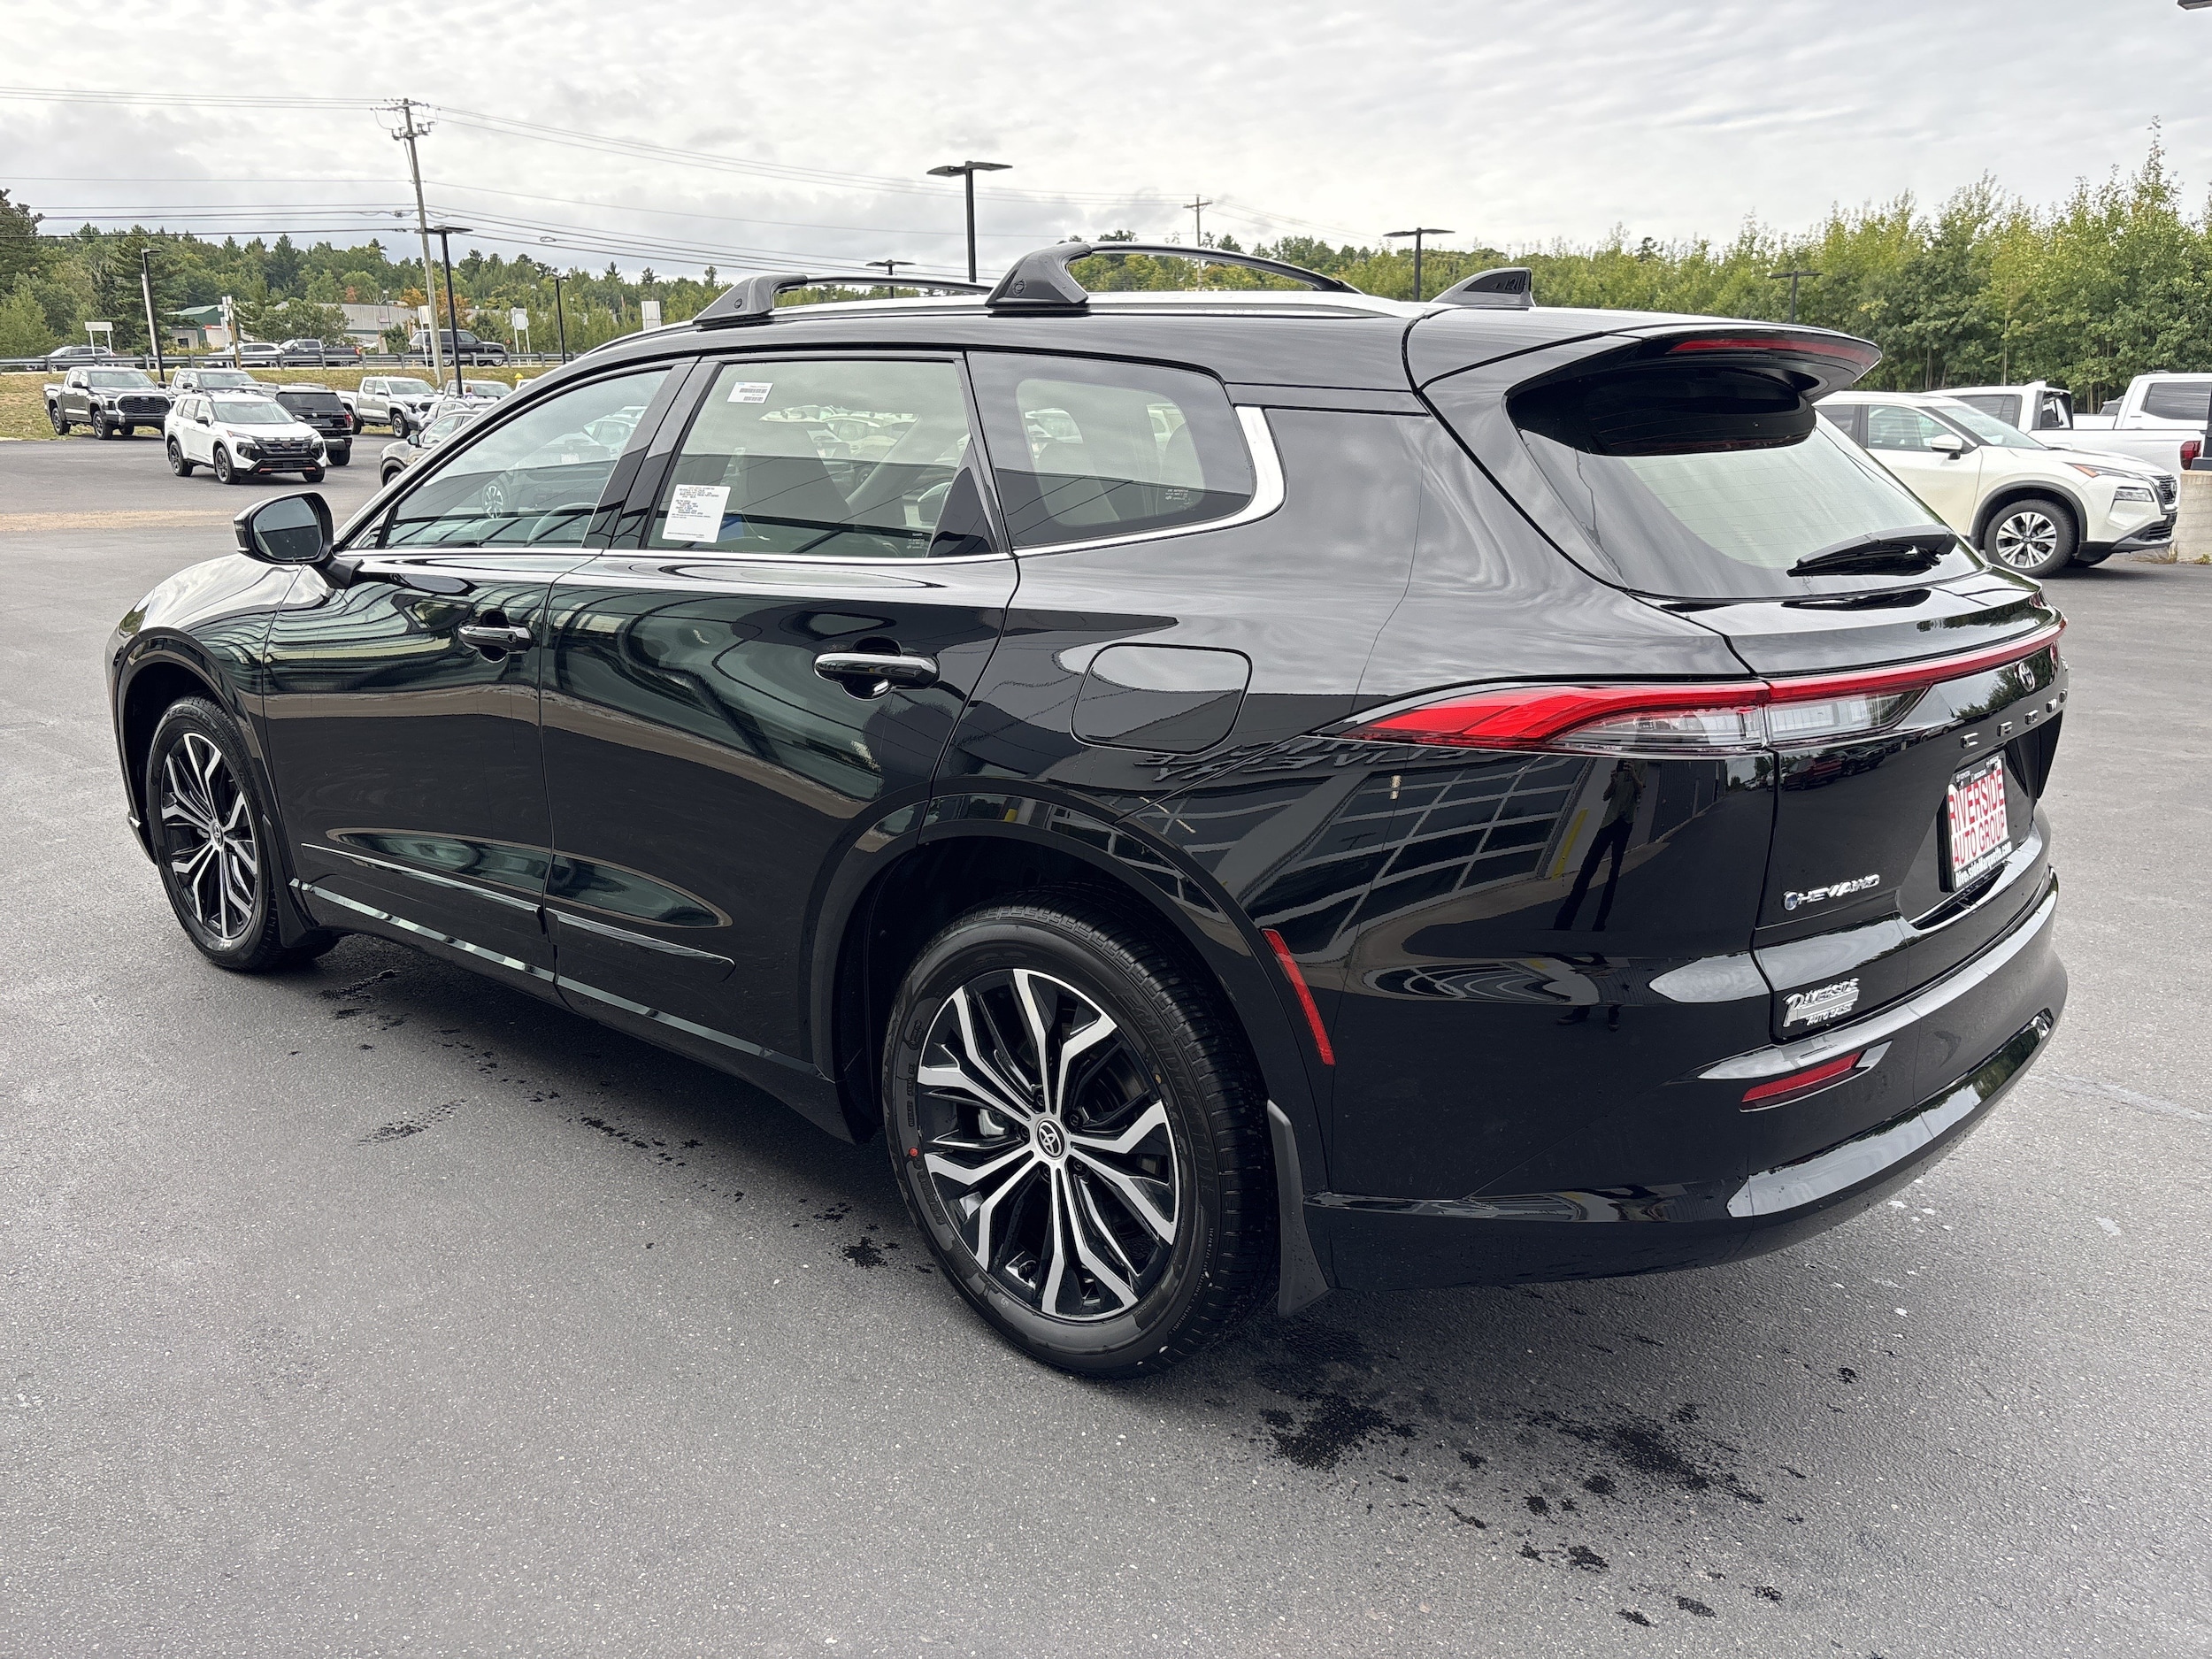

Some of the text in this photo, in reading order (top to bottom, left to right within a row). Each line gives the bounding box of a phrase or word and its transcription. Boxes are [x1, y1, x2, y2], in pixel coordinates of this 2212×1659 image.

[1948, 769, 2006, 835] RIVERSIDE
[1953, 810, 2005, 867] AUTO GROUP
